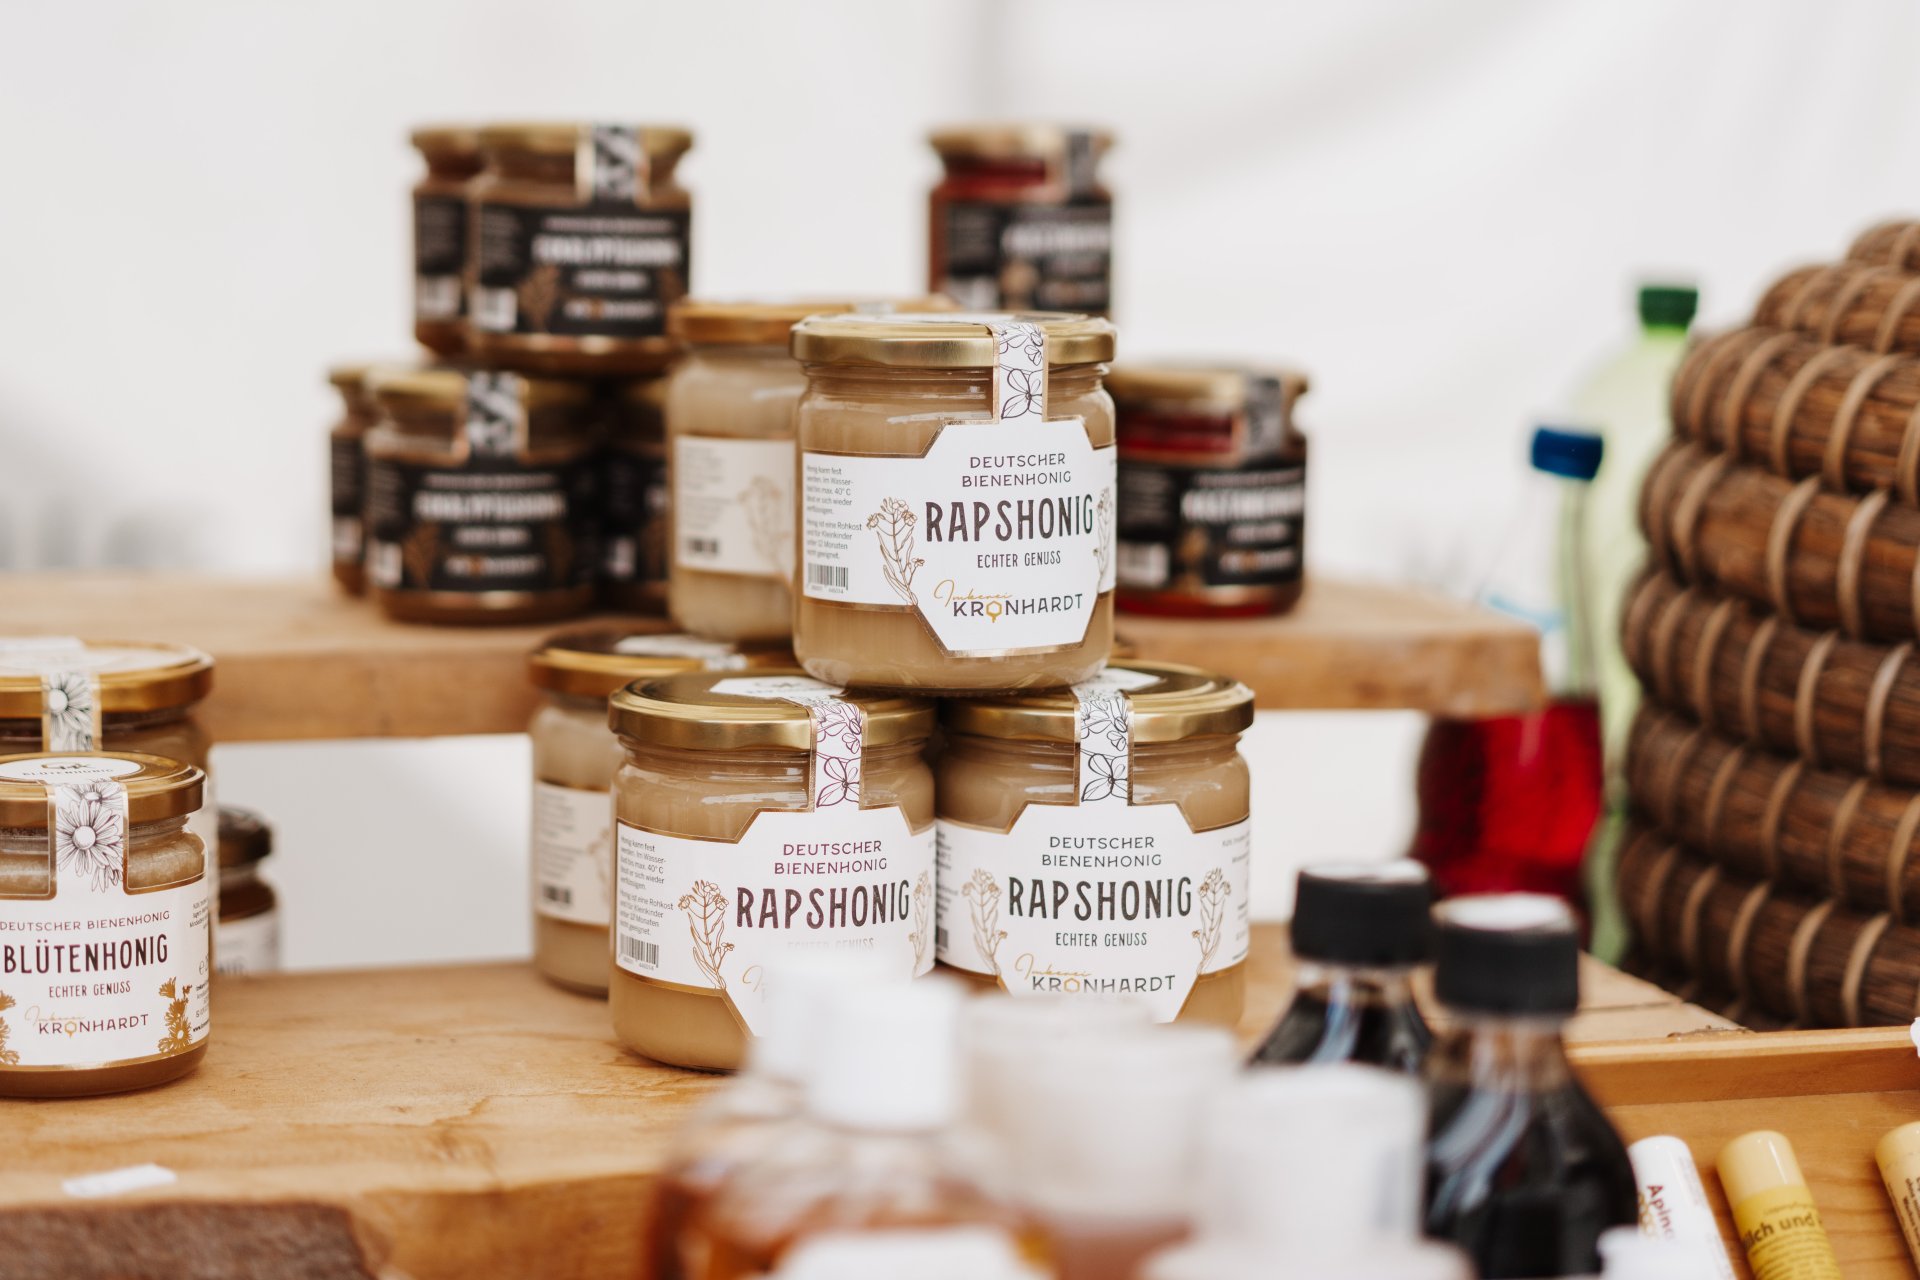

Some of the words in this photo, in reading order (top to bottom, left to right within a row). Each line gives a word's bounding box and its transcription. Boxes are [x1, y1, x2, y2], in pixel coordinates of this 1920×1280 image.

[970, 453, 1065, 469] DEUTSCHER
[961, 471, 1071, 487] BIENENHONIG
[925, 494, 1093, 542] RAPSHONIG
[977, 554, 1018, 569] ECHTER
[1024, 551, 1061, 567] GENUSS
[933, 579, 1011, 608] Imkerei
[952, 594, 1083, 623] KRONHARDT
[783, 840, 882, 857] DEUTSCHER
[1049, 836, 1155, 850] DEUTSCHER
[774, 858, 888, 875] BIENENHONIG
[1041, 854, 1162, 868] BIENENHONIG
[736, 880, 911, 930] RAPSHONIG
[1009, 877, 1192, 921] RAPSHONIG
[0, 921, 81, 931] DEUTSCHER
[87, 910, 171, 930] BIENENHONIG
[1055, 932, 1098, 947] ECHTER
[1105, 932, 1148, 947] GENUSS
[4, 933, 168, 974] BLÜTENHONIG
[1014, 953, 1092, 979] Imkerei
[49, 984, 88, 998] ECHTER
[93, 980, 131, 996] GENUSS
[1032, 975, 1175, 994] KRONHARDT
[39, 1013, 149, 1038] KRONHARDT
[1779, 1212, 1813, 1231] und
